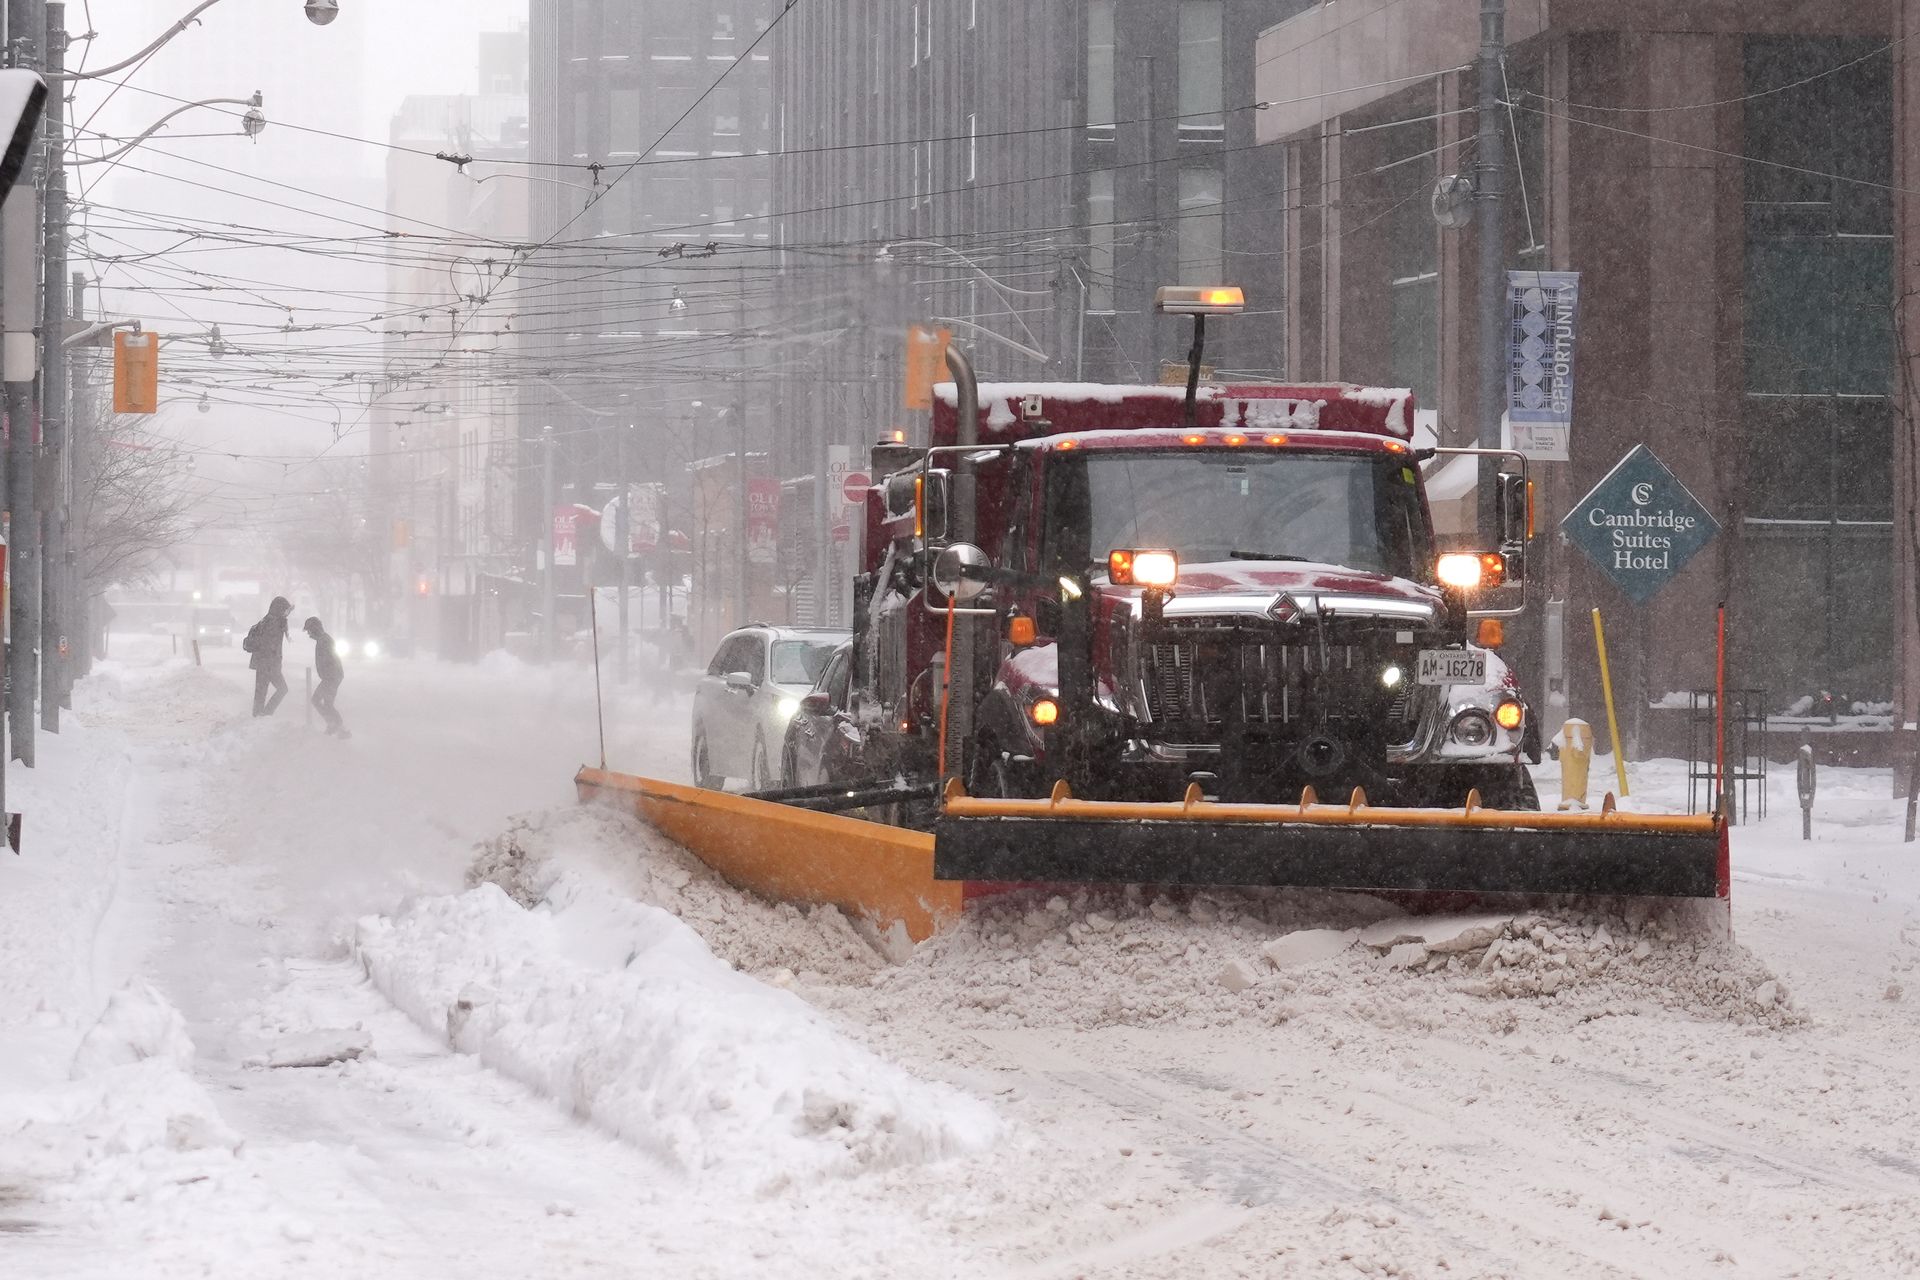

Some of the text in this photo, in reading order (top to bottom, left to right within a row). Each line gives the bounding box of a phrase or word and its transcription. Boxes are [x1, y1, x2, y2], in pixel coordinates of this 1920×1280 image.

[1553, 281, 1575, 414] OPPORTUNITY
[831, 462, 849, 473] OL
[1589, 508, 1696, 532] Cambridge
[1613, 529, 1671, 549] Suites
[1613, 550, 1669, 570] Hotel
